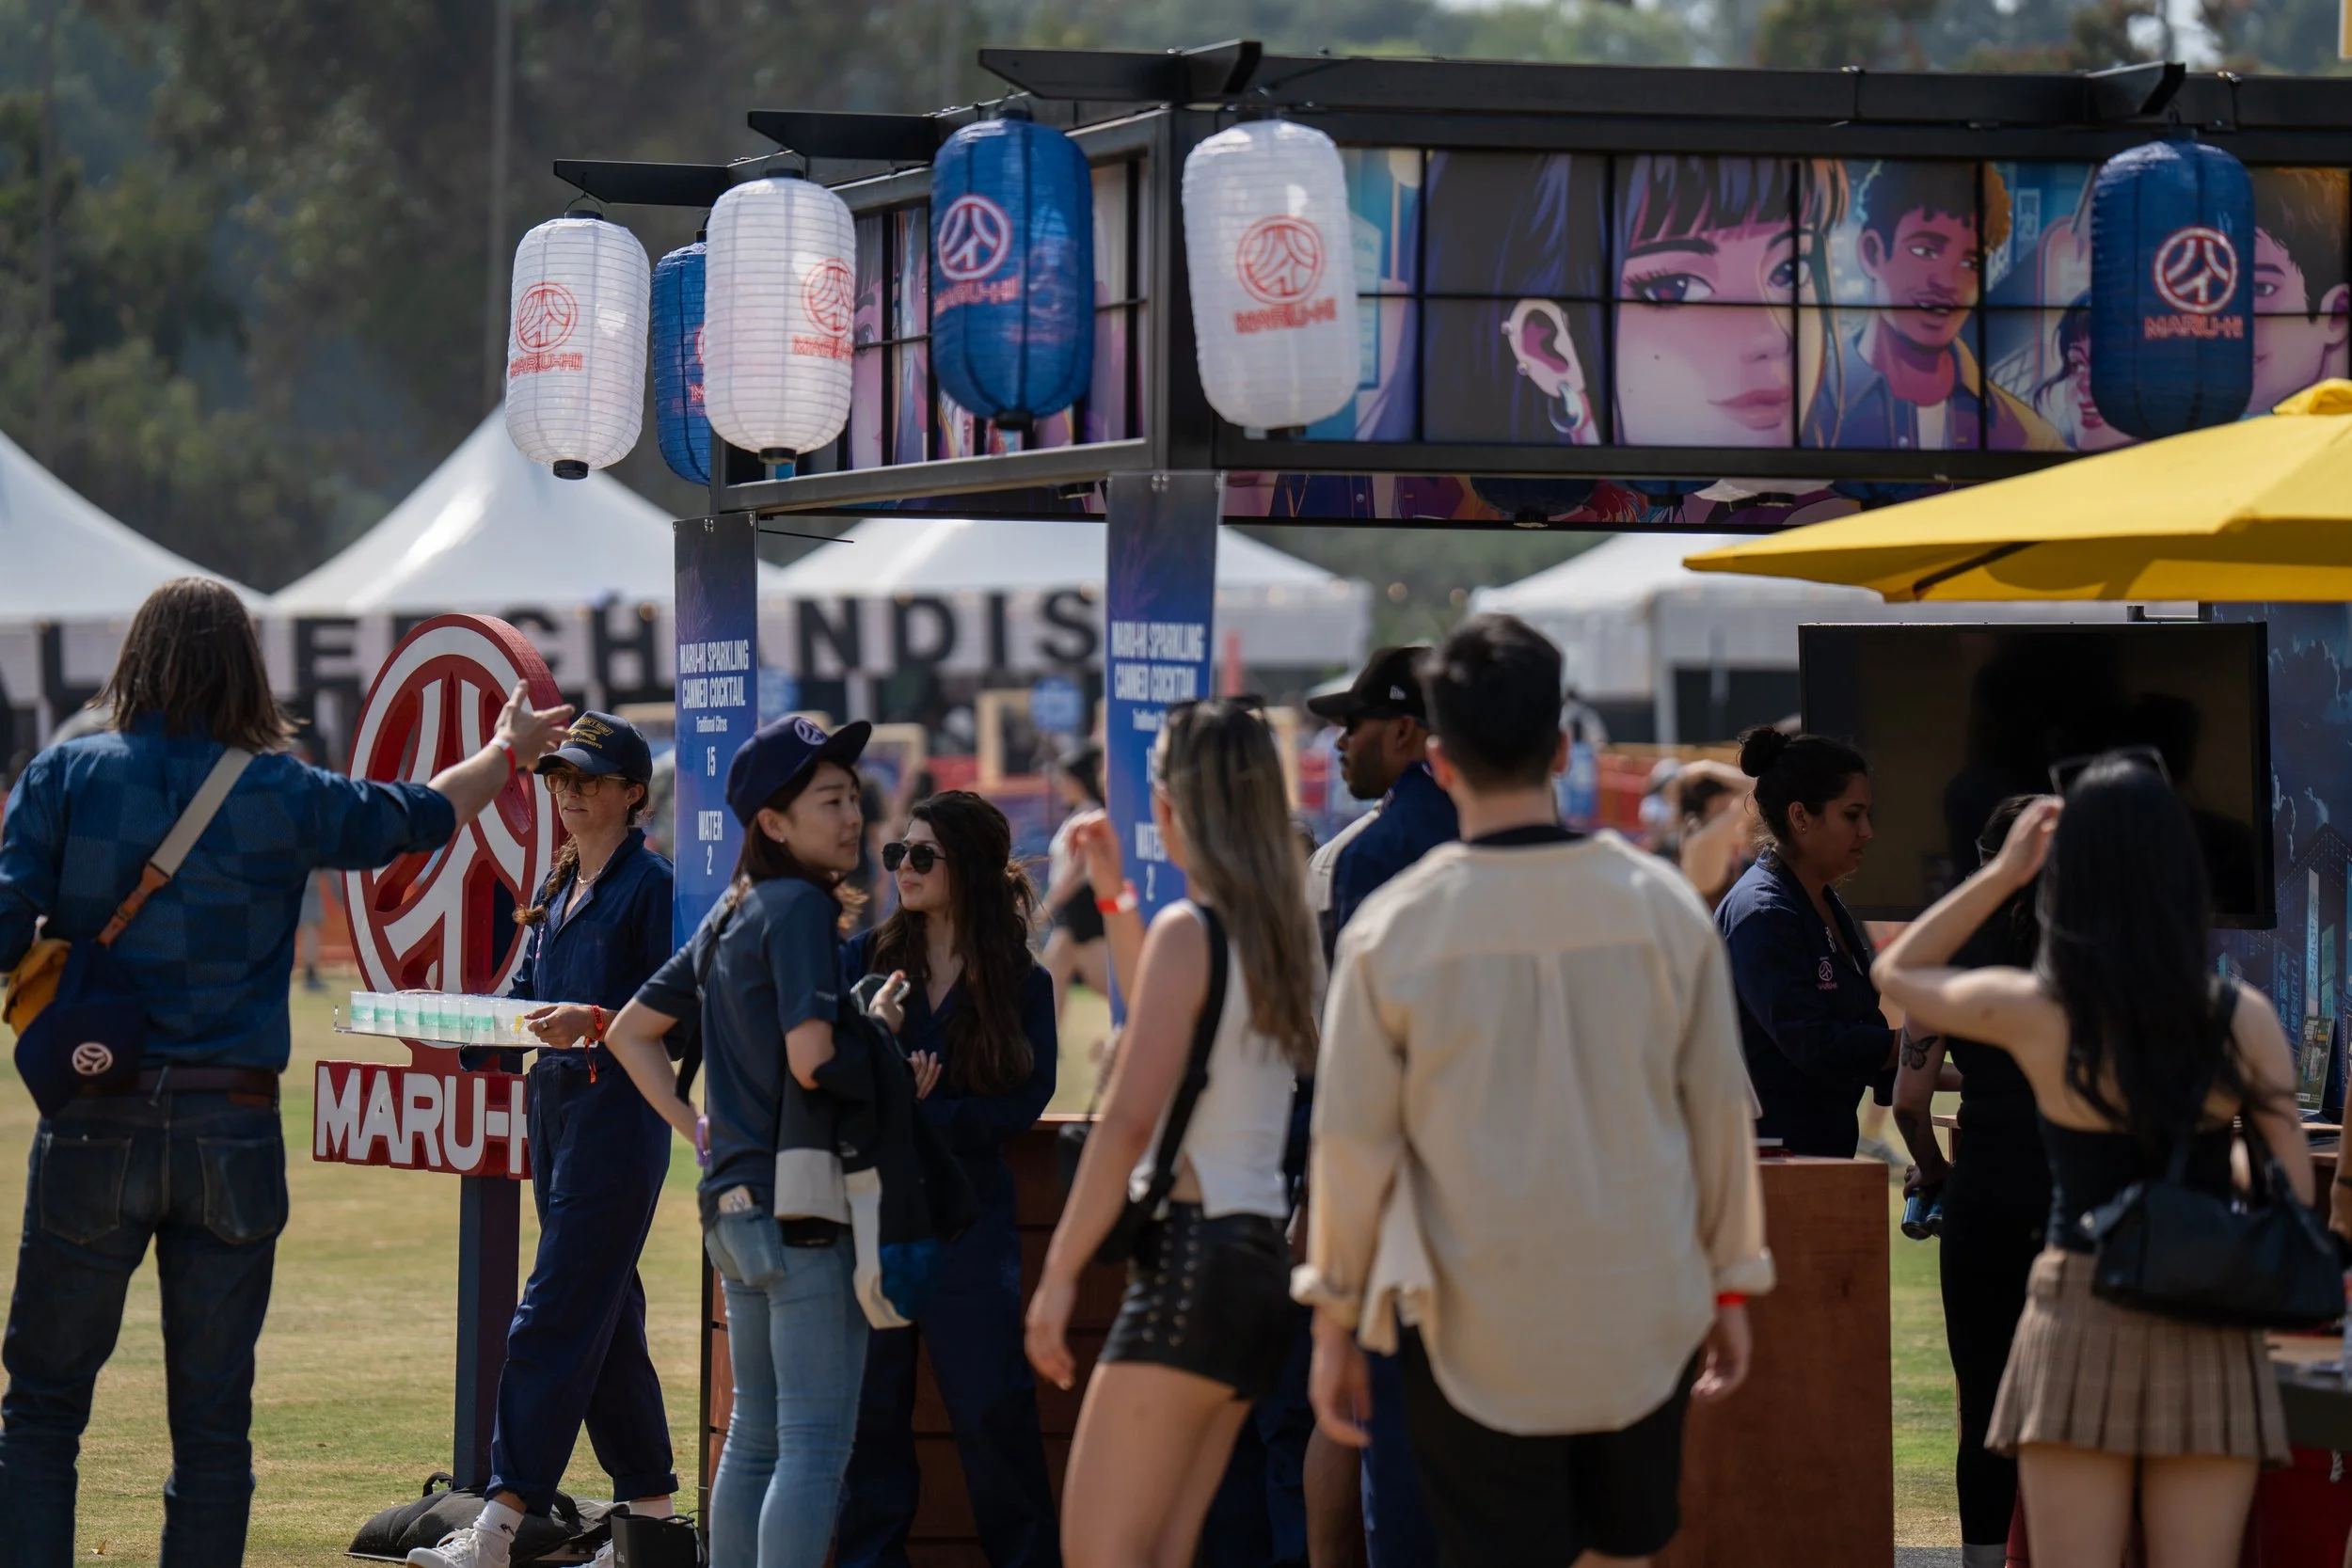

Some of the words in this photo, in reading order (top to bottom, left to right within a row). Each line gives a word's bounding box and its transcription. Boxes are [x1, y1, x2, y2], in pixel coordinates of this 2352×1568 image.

[934, 276, 1020, 315] MARU-HI
[1235, 296, 1336, 334] MARU-HI
[2144, 315, 2244, 340] MARU-HI
[509, 353, 582, 378] MARU-HI
[680, 642, 707, 674] MARU-HI
[707, 640, 749, 672] SPARKLING
[682, 678, 708, 709] CANNED
[709, 676, 746, 708] COCKTAIL
[696, 716, 715, 733] Traditional
[707, 746, 716, 776] 15
[698, 811, 723, 841] WATER
[707, 845, 712, 876] 2
[1146, 863, 1156, 902] 2
